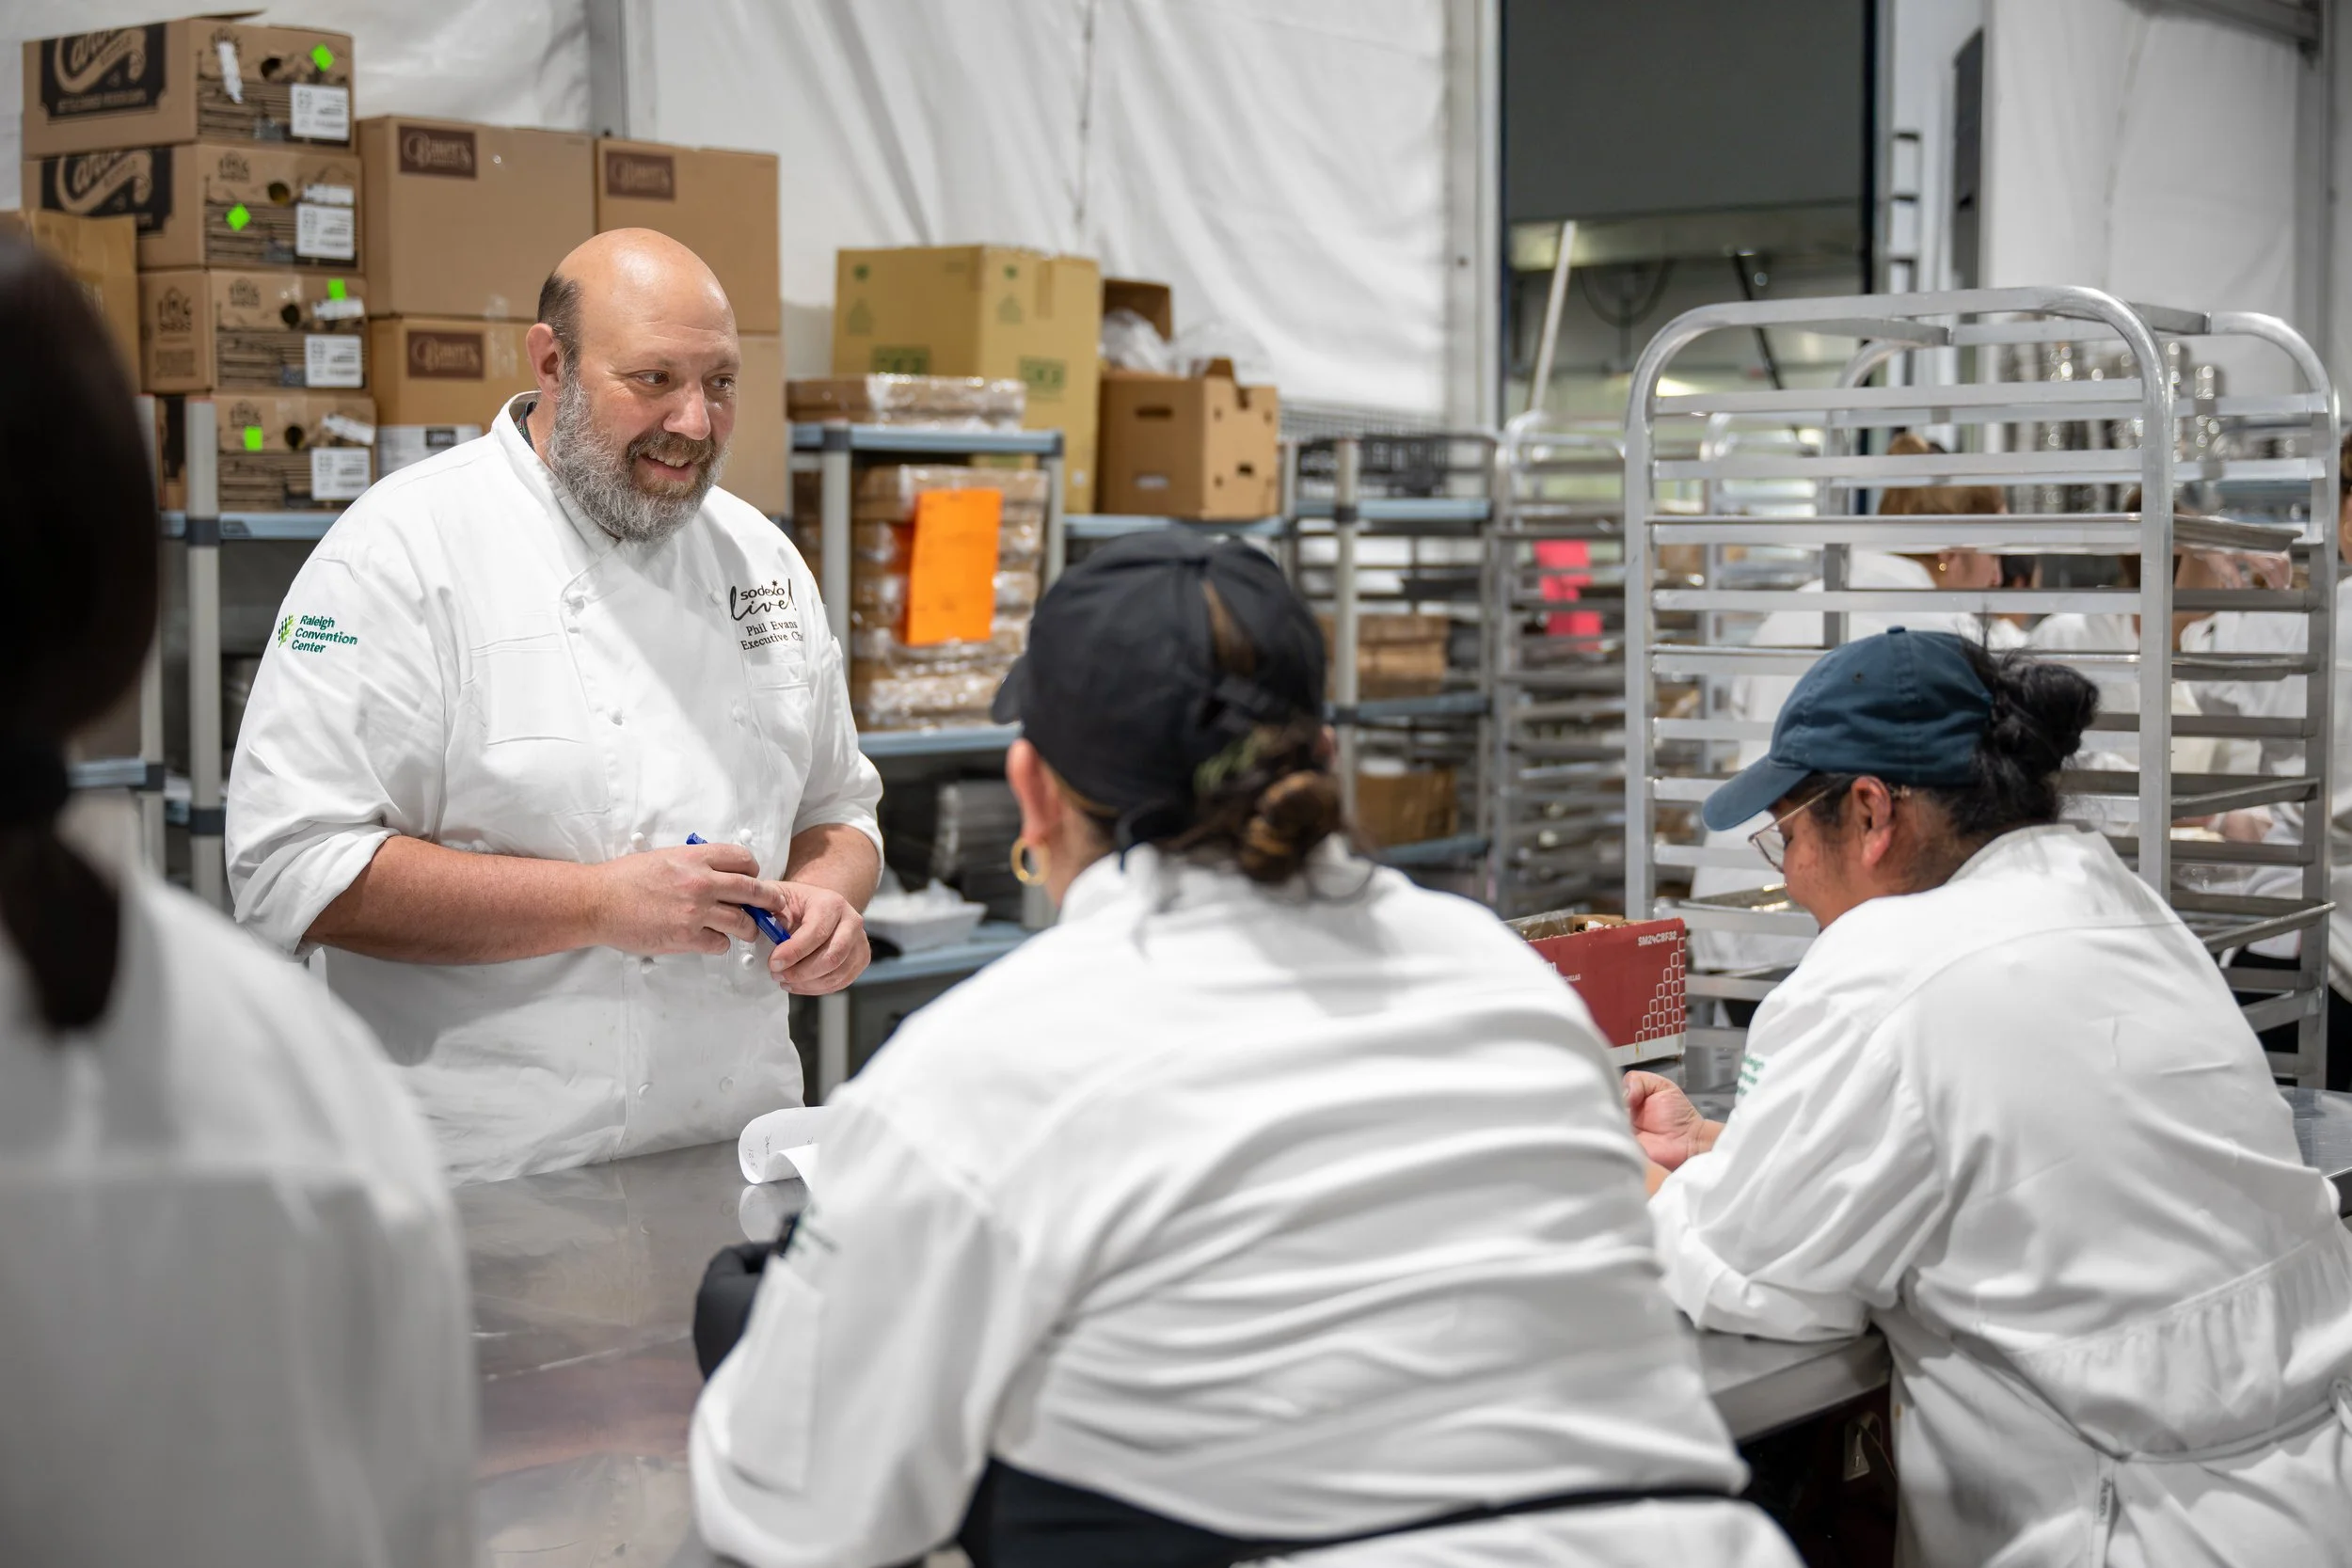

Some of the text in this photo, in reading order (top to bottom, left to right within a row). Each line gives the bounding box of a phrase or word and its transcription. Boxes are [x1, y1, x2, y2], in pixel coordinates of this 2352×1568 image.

[740, 579, 786, 601] sodexo
[300, 615, 335, 630] Raleigh
[746, 621, 798, 637] Phil Evans
[295, 627, 358, 645] Convention
[740, 633, 788, 651] Executive
[292, 640, 326, 653] Center
